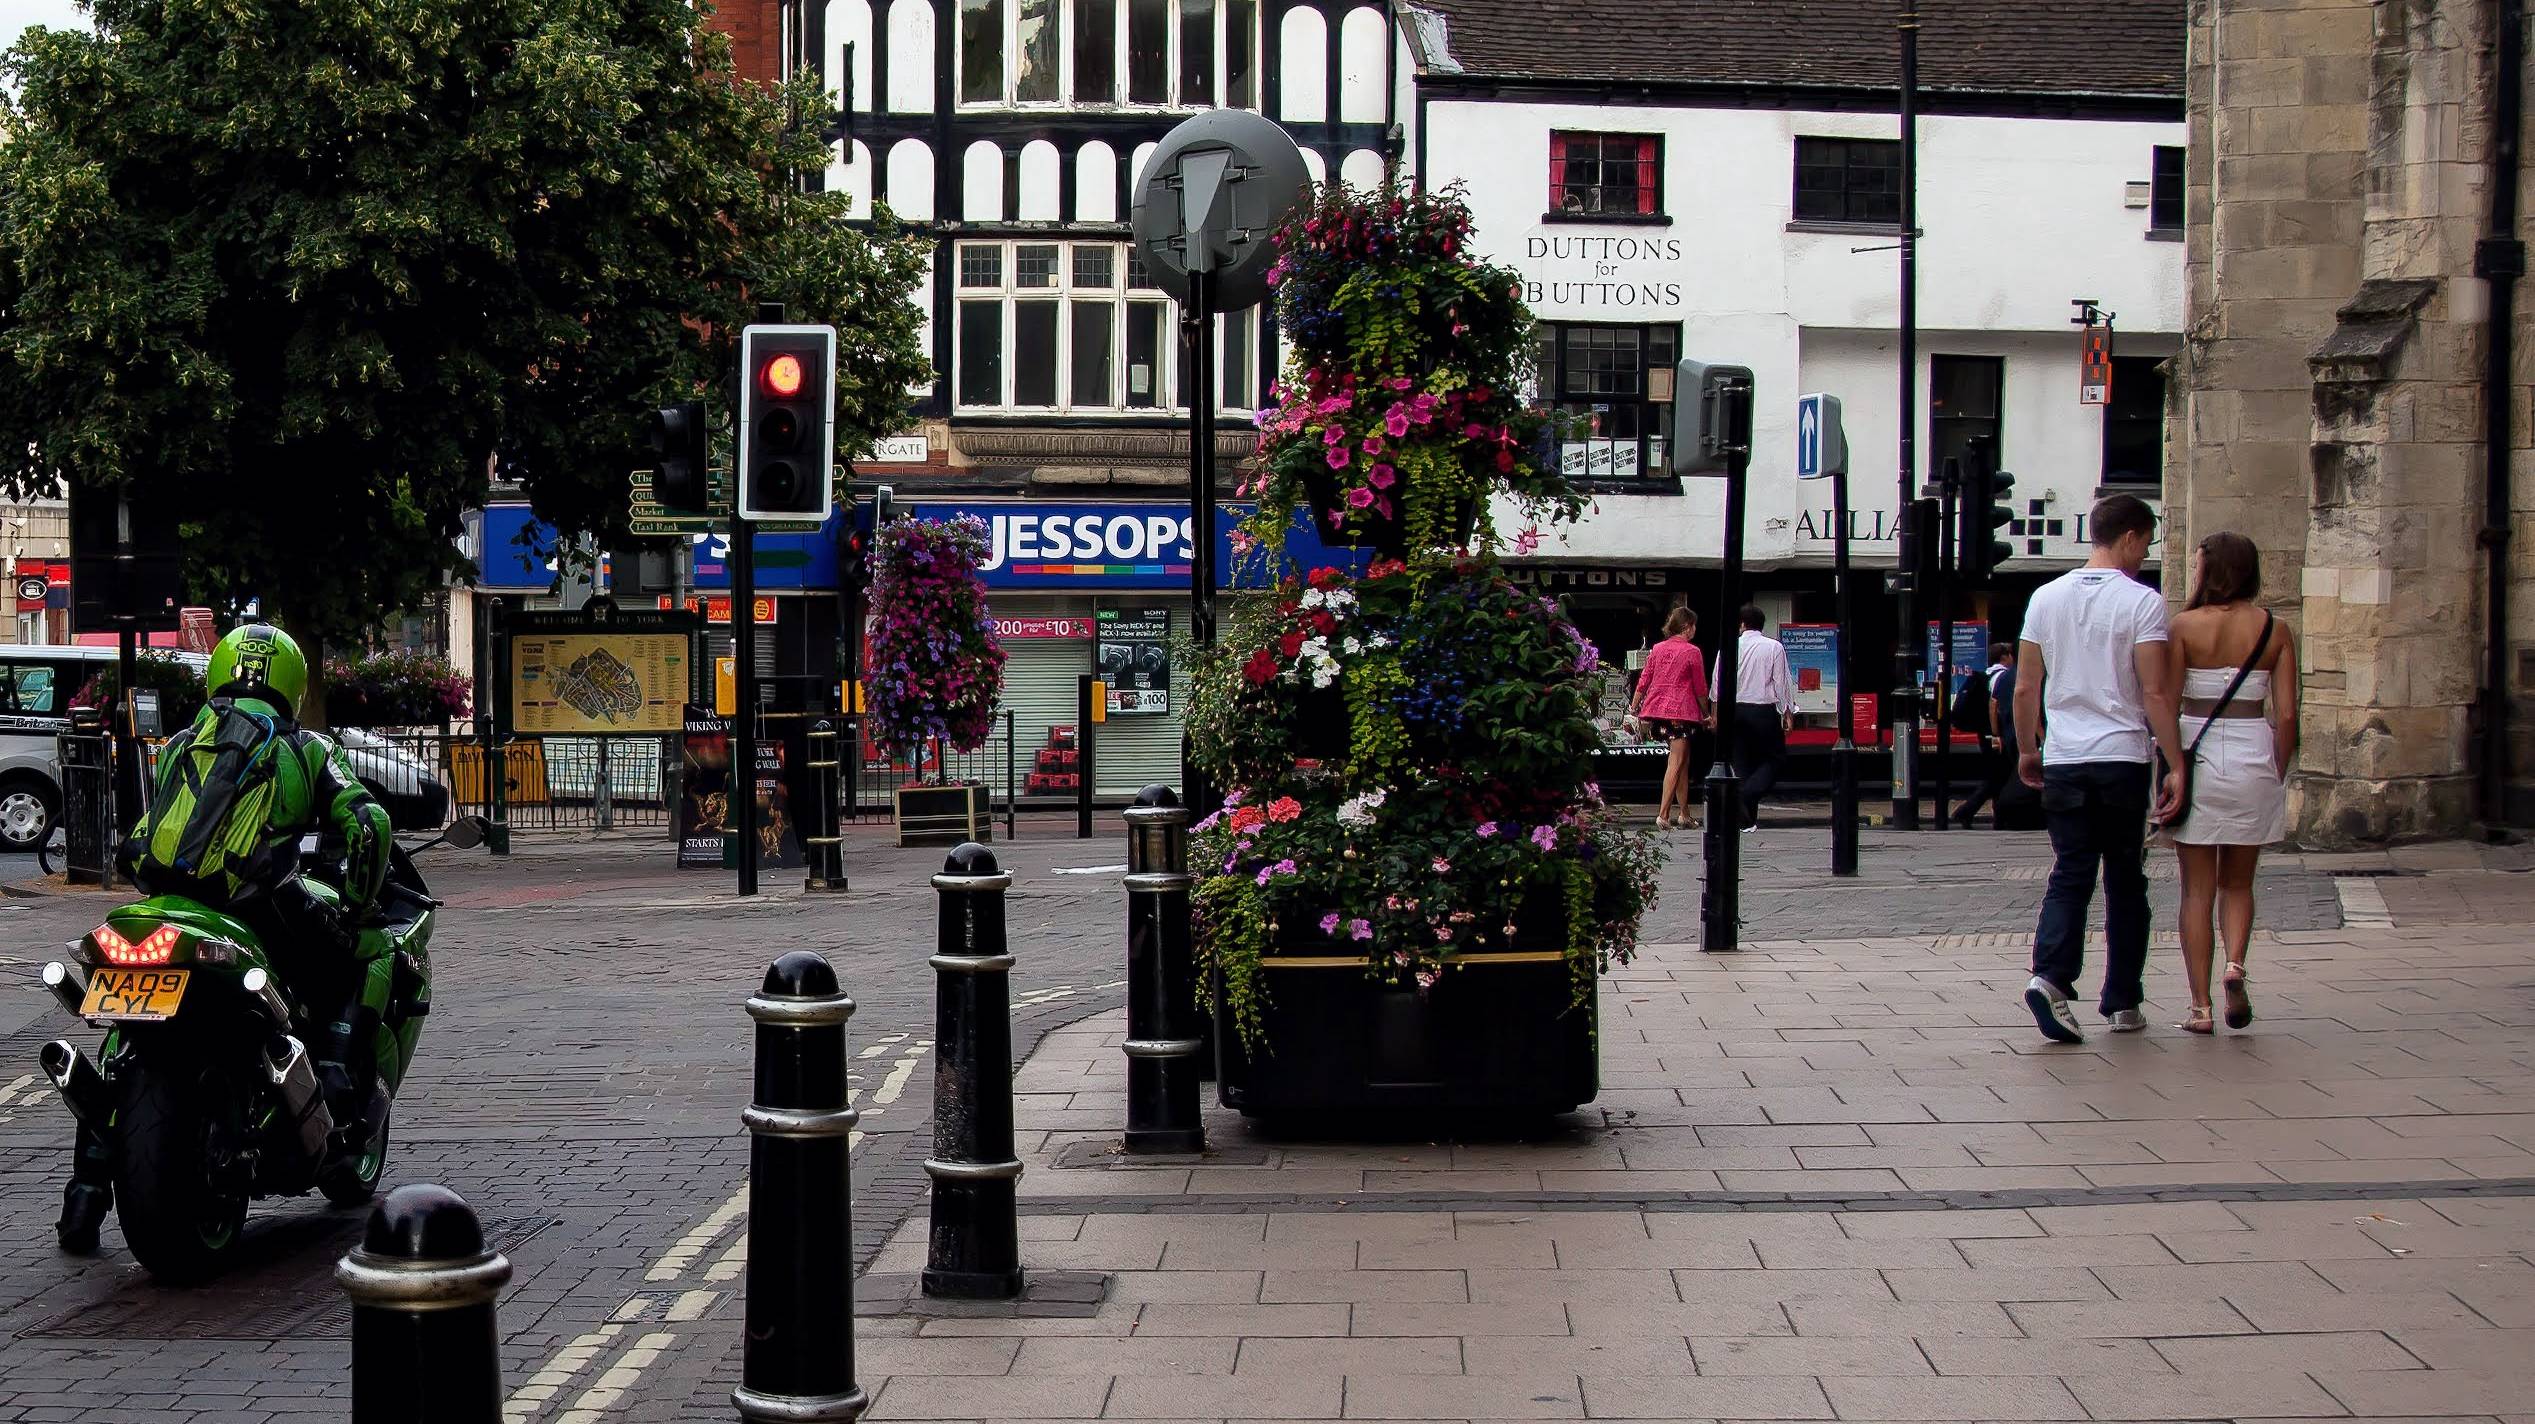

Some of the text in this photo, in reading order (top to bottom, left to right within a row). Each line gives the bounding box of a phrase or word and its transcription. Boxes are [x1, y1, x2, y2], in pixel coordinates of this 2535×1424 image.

[1527, 237, 1681, 261] DUTTONS
[1595, 260, 1618, 279] for
[1527, 282, 1681, 306] BUTTONS
[874, 443, 922, 455] RGATE
[635, 507, 665, 516] Market
[656, 521, 679, 532] Rank
[1512, 570, 1666, 588] UTTON'S
[616, 615, 630, 625] TO
[636, 615, 664, 625] YORK
[993, 620, 1022, 635] 200
[1045, 620, 1070, 635] £10
[685, 720, 722, 732] VIKING
[686, 838, 719, 849] STARTS
[95, 972, 182, 993] NA09
[98, 992, 160, 1015] CYL
